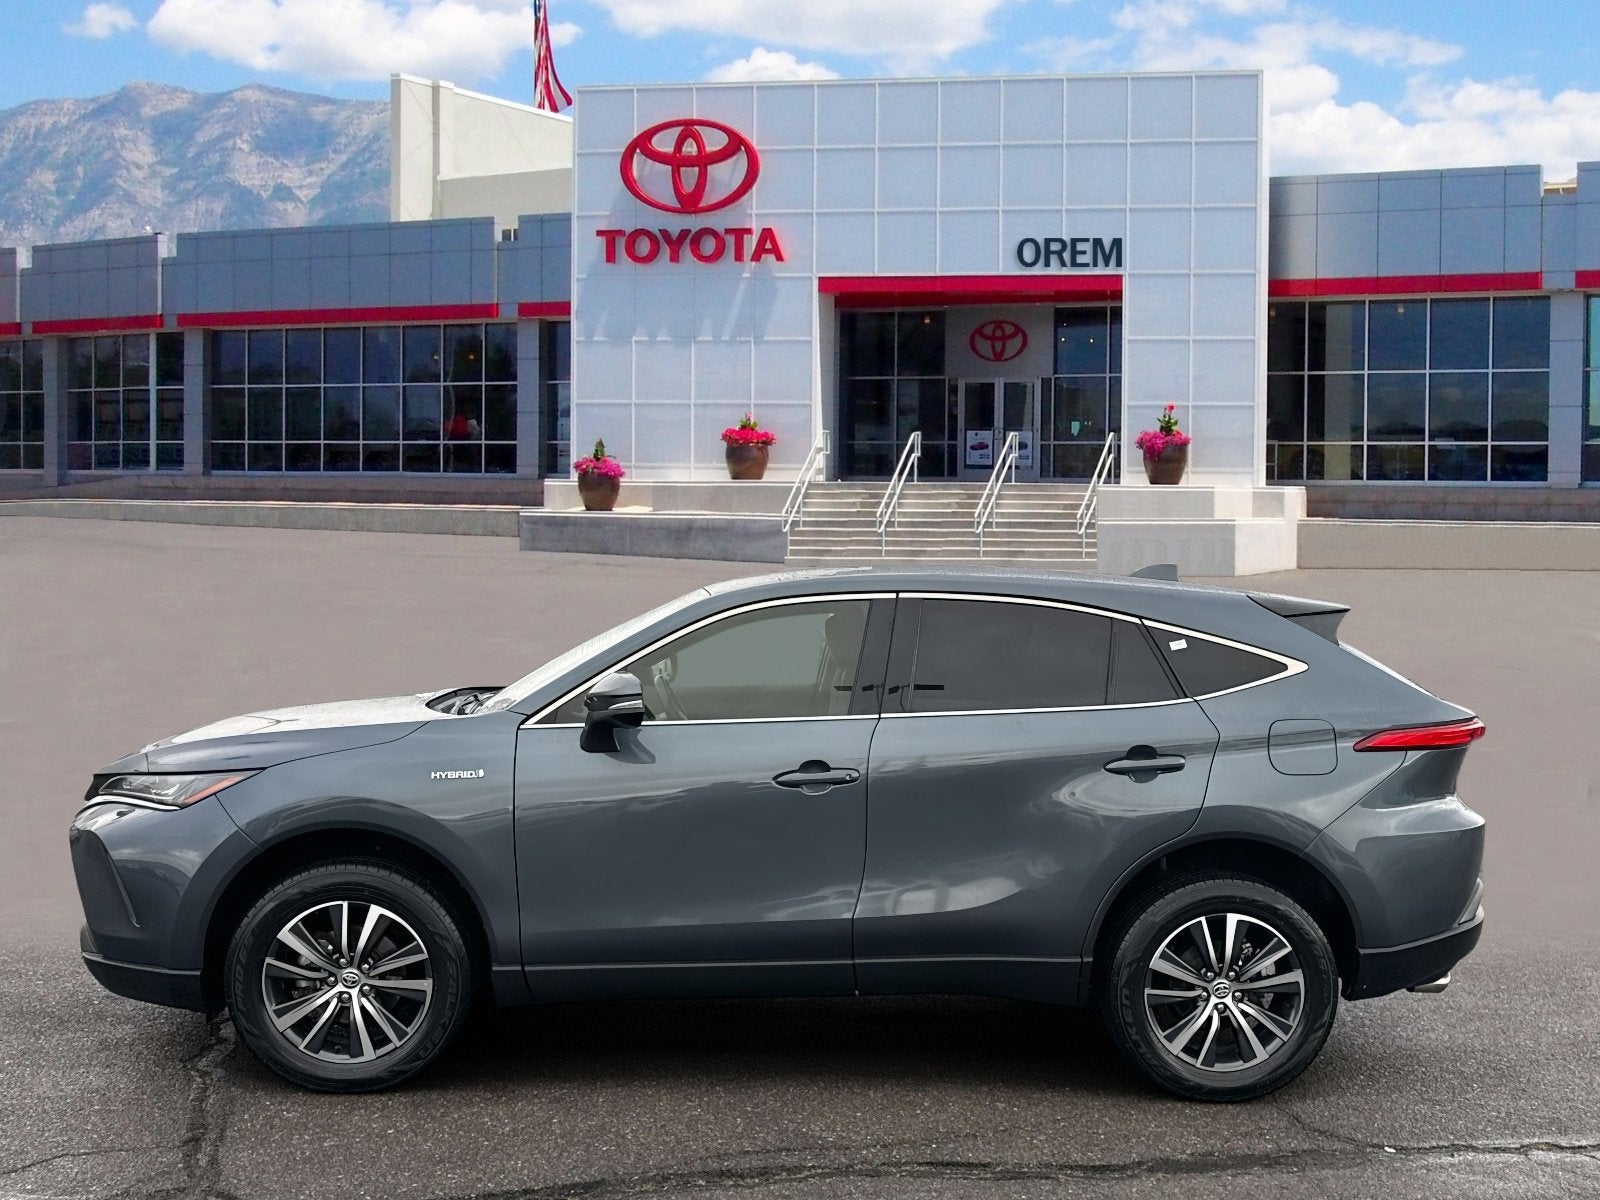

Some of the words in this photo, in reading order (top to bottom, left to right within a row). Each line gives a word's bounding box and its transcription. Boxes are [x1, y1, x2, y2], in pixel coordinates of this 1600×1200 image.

[596, 227, 784, 264] TOYOTA
[1017, 237, 1122, 268] OREM
[431, 770, 476, 779] HYBRID
